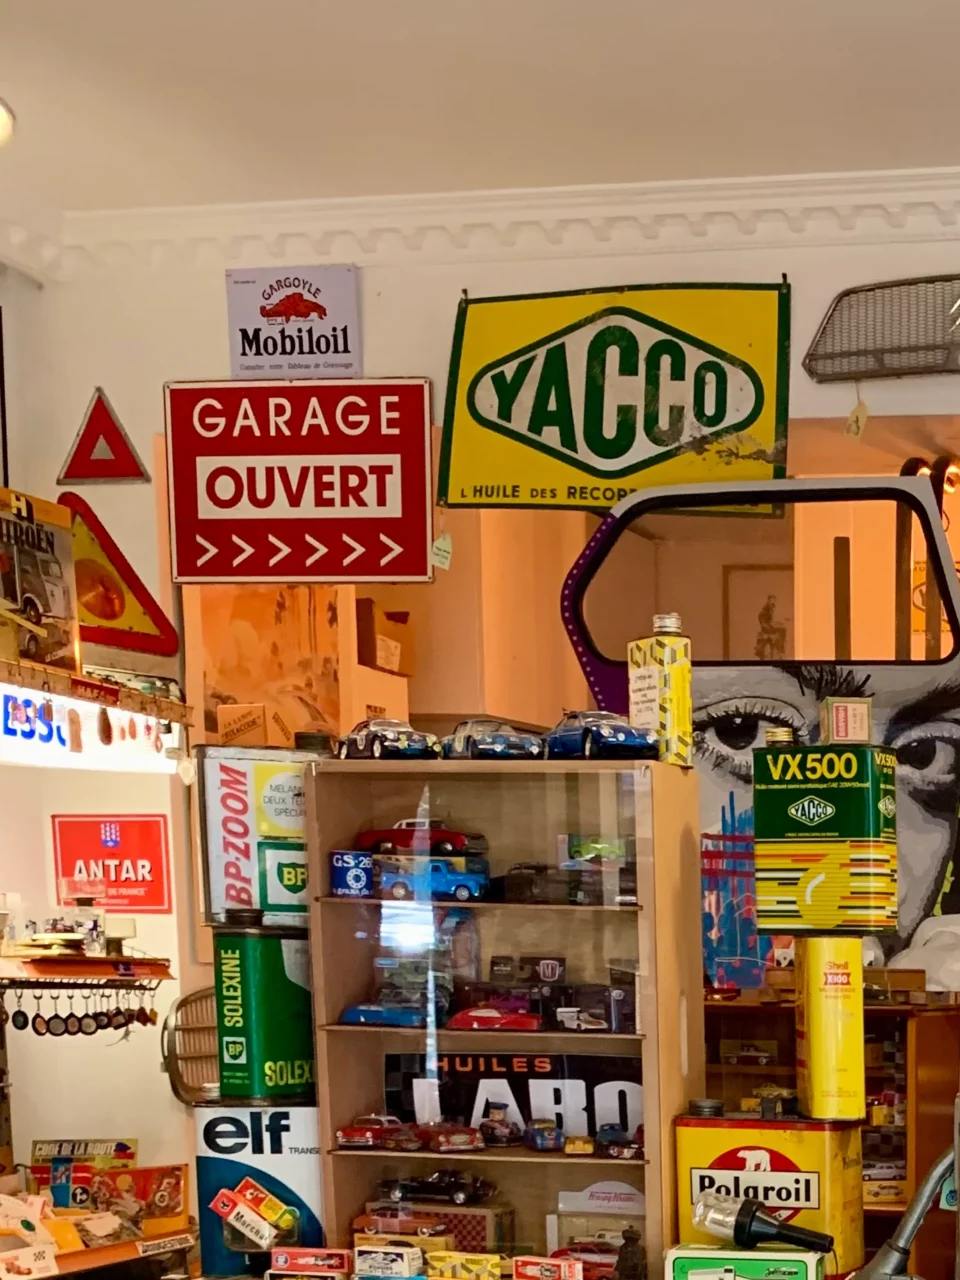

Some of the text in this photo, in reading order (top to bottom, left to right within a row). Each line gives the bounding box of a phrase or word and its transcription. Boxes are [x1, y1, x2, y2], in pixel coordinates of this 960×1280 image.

[262, 277, 322, 300] GARGOYLE
[239, 325, 351, 356] Mobiloil
[490, 325, 728, 459] YACCO
[193, 395, 400, 438] GARAGE
[206, 464, 393, 509] OUVERT
[530, 488, 557, 499] DES
[263, 795, 286, 804] DEUX
[794, 800, 828, 822] YACCO
[73, 859, 153, 882] ANTAR
[827, 961, 848, 970] Shell
[221, 949, 243, 1027] SOLEXINE
[228, 1043, 243, 1055] BP
[433, 1057, 552, 1072] HUILES
[203, 1111, 291, 1154] elf
[35, 1142, 115, 1156] CODE DE LA ROUTE
[699, 1174, 811, 1202] Polaroil
